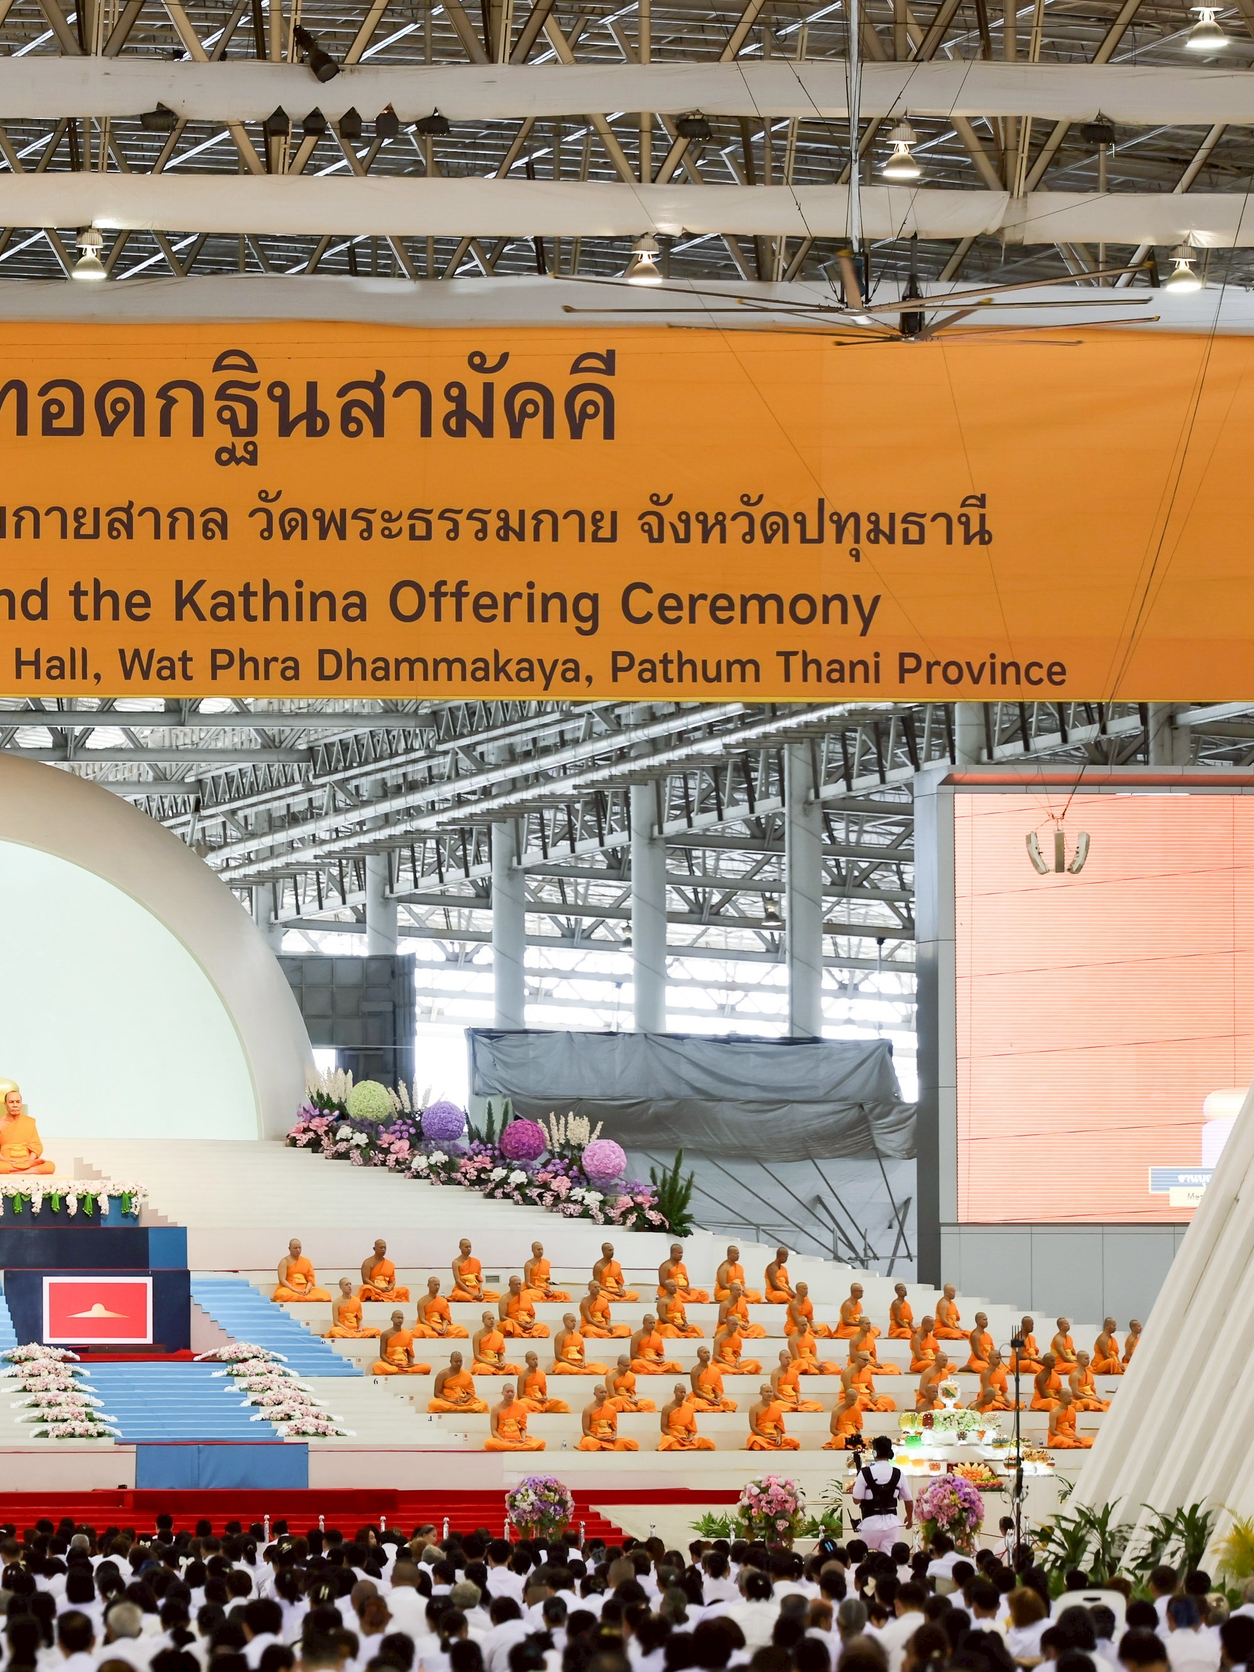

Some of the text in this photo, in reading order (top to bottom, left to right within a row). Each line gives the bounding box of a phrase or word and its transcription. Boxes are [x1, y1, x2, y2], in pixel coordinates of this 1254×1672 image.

[248, 490, 618, 543] วัดพระธรรมกาย
[638, 492, 993, 562] จังหวัดปทุมธานี
[69, 578, 151, 622] the
[176, 579, 367, 623] Kathina
[389, 580, 599, 636] Offering
[621, 582, 882, 637] Ceremony
[15, 646, 102, 685] Hall,
[118, 648, 194, 681] Wat
[210, 647, 300, 682] Phra
[318, 648, 593, 692] Dhammakaya,
[611, 650, 761, 684] Pathum
[775, 650, 881, 684] Thani
[898, 652, 1067, 687] Province
